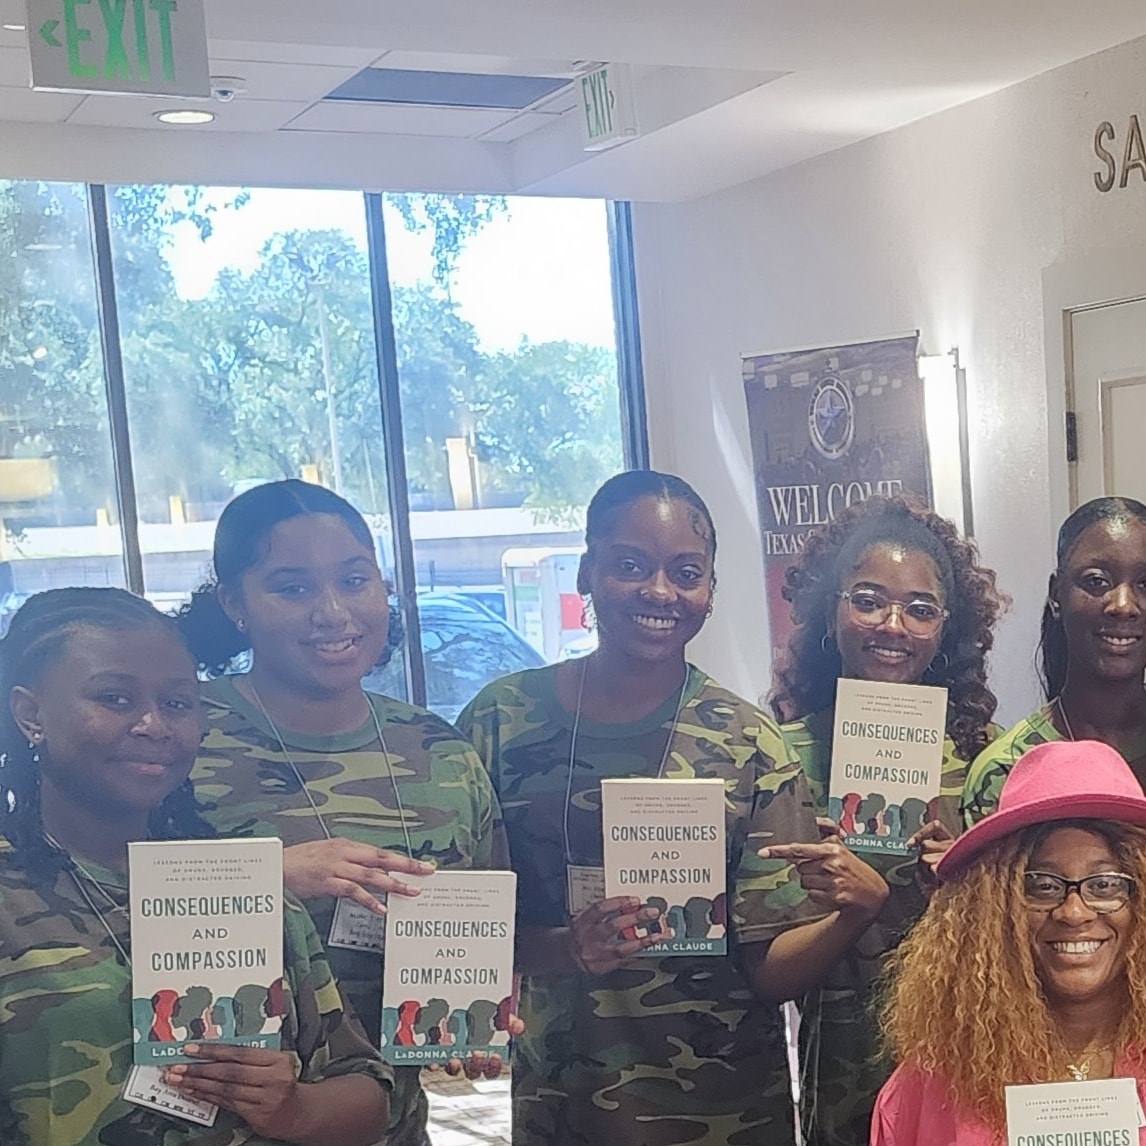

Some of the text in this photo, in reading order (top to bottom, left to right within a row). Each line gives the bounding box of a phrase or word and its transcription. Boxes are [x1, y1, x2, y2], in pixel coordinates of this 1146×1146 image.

[64, 0, 178, 83] EXIT
[581, 70, 612, 138] EXIT
[842, 720, 938, 745] CONSEQUENCES
[875, 749, 903, 760] AND
[845, 763, 929, 785] COMPASSION
[611, 825, 717, 841] CONSEQUENCES
[651, 851, 680, 861] AND
[620, 868, 711, 885] COMPASSION
[141, 894, 274, 917] CONSEQUENCES
[192, 928, 228, 940] AND
[395, 920, 507, 938] CONSEQUENCES
[435, 948, 467, 959] AND
[672, 942, 713, 951] CLAUDE
[152, 948, 267, 971] COMPASSION
[400, 968, 498, 985] COMPASSION
